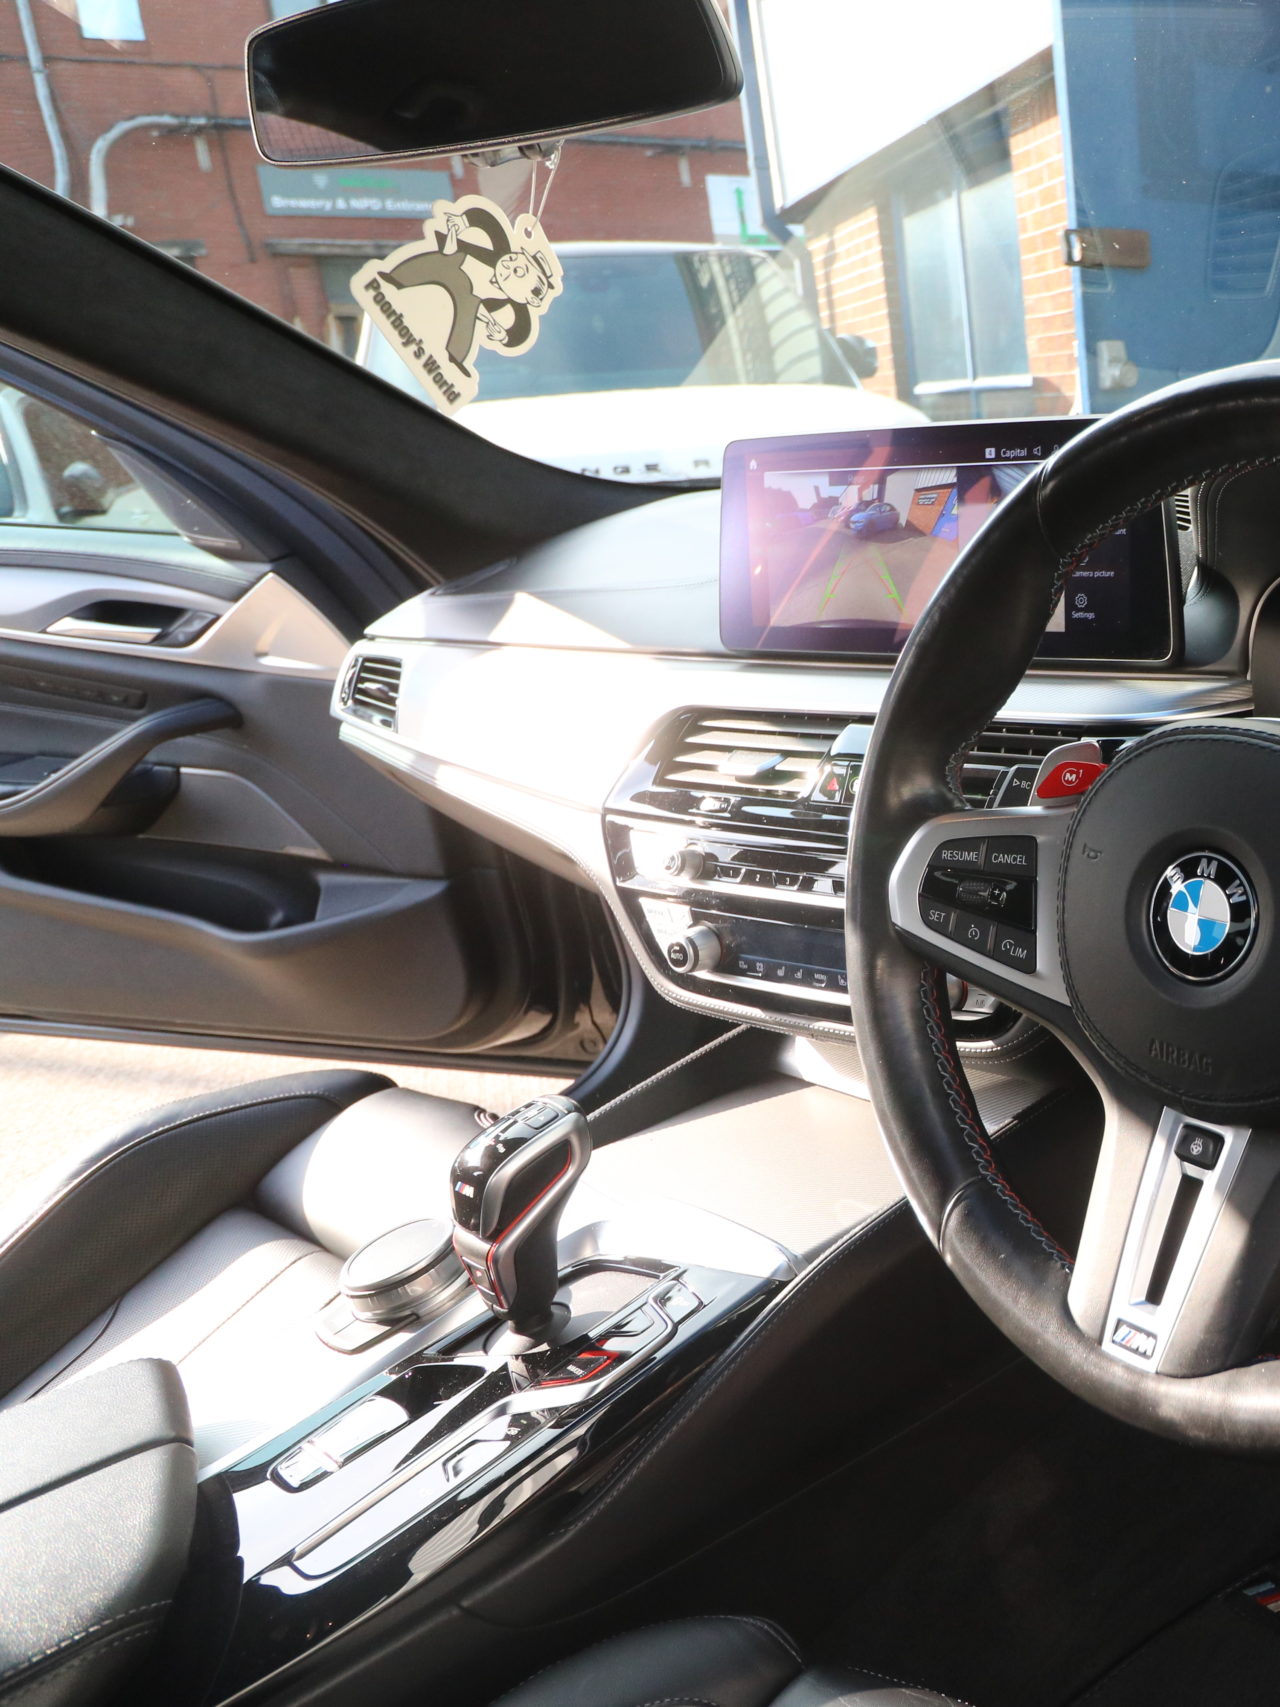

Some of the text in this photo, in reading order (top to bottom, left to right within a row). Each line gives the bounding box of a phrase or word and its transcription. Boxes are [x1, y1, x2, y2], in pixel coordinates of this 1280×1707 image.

[270, 195, 333, 211] Brewery
[335, 198, 347, 210] &
[364, 277, 461, 405] Poorboy's World
[1000, 447, 1028, 459] Capital
[1072, 570, 1115, 578] amera picture
[1072, 610, 1096, 619] Settings
[1020, 780, 1032, 790] BC
[941, 849, 979, 862] RESUME
[991, 853, 1028, 866] CANCEL
[1166, 858, 1247, 904] BMW
[928, 909, 946, 923] SET
[1010, 946, 1027, 959] LIM
[1149, 1038, 1212, 1076] AIRBAG
